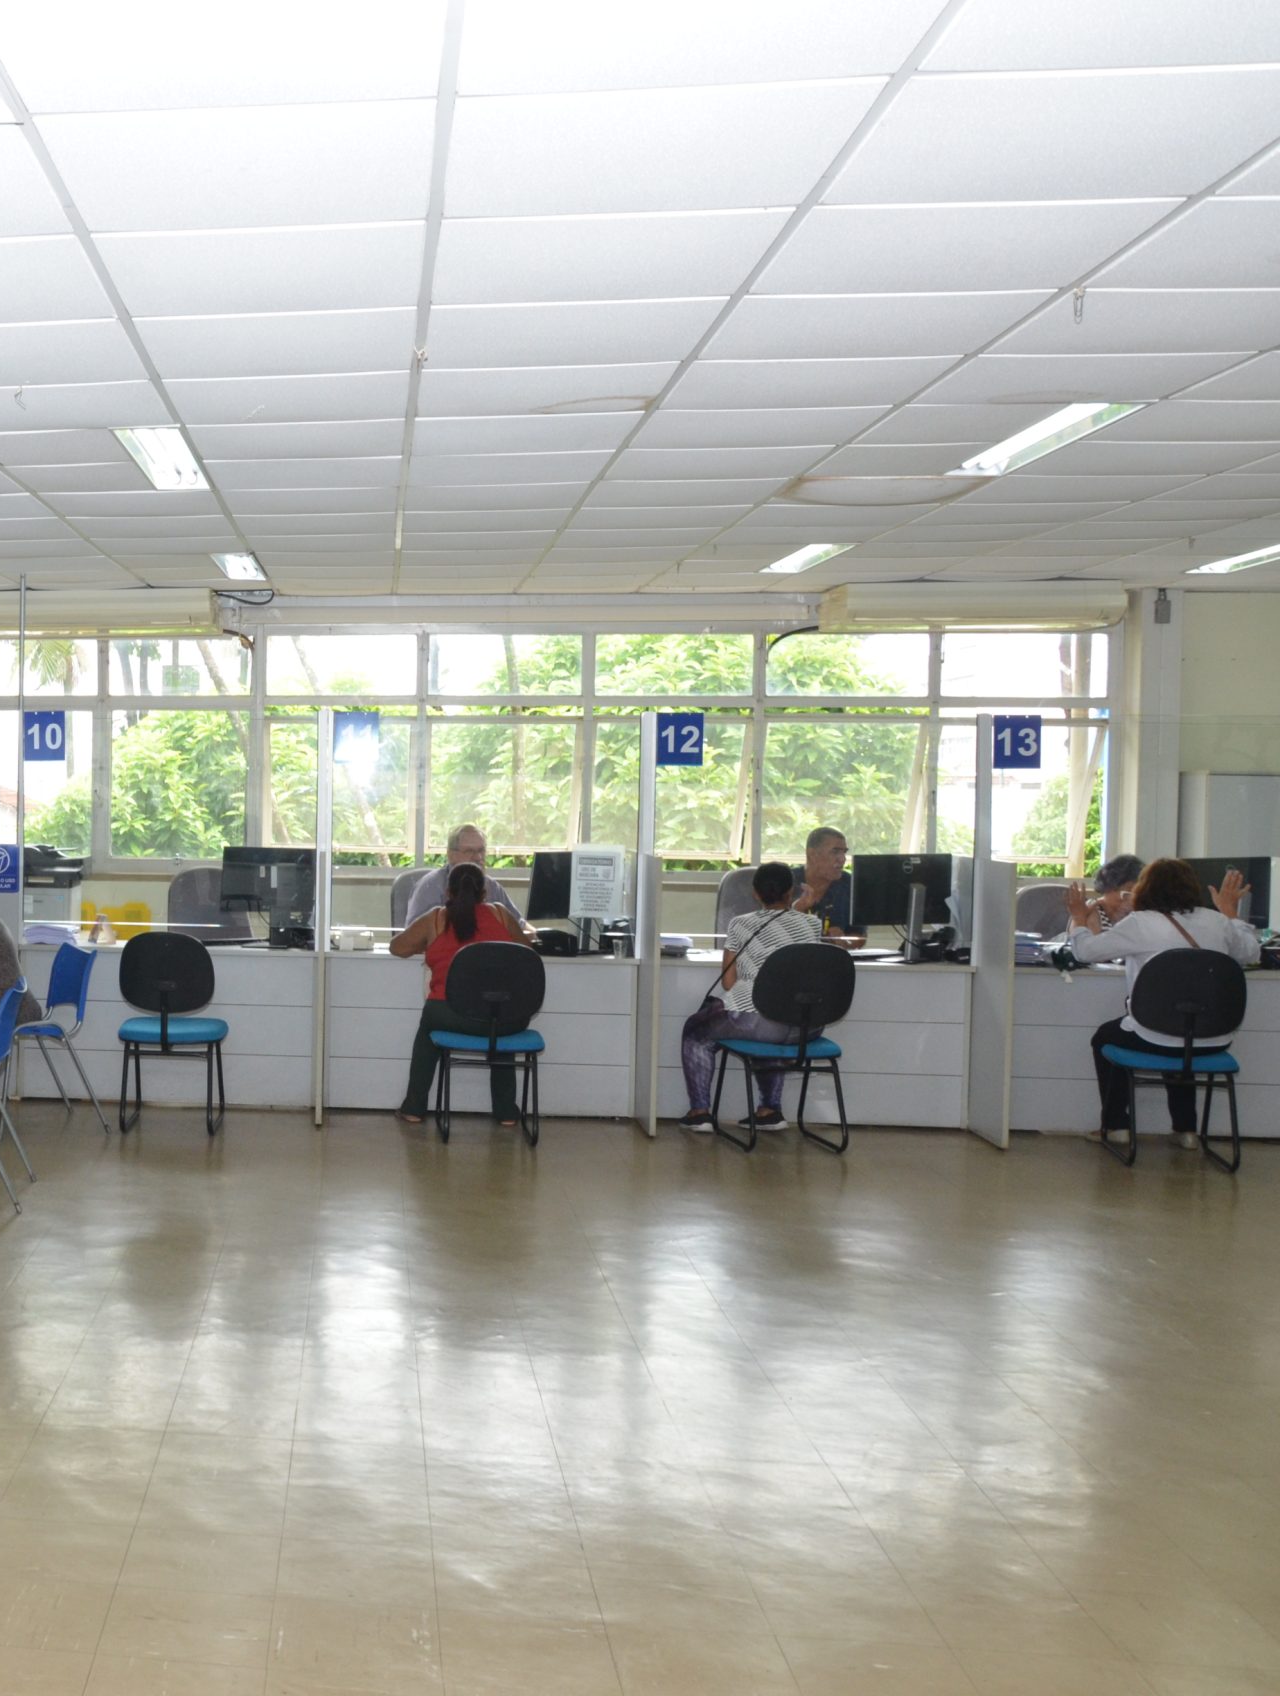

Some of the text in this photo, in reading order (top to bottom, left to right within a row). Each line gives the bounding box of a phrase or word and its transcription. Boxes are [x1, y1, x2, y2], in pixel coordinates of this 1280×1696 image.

[27, 723, 62, 750] 10
[661, 725, 700, 753] 12
[997, 727, 1038, 757] 13
